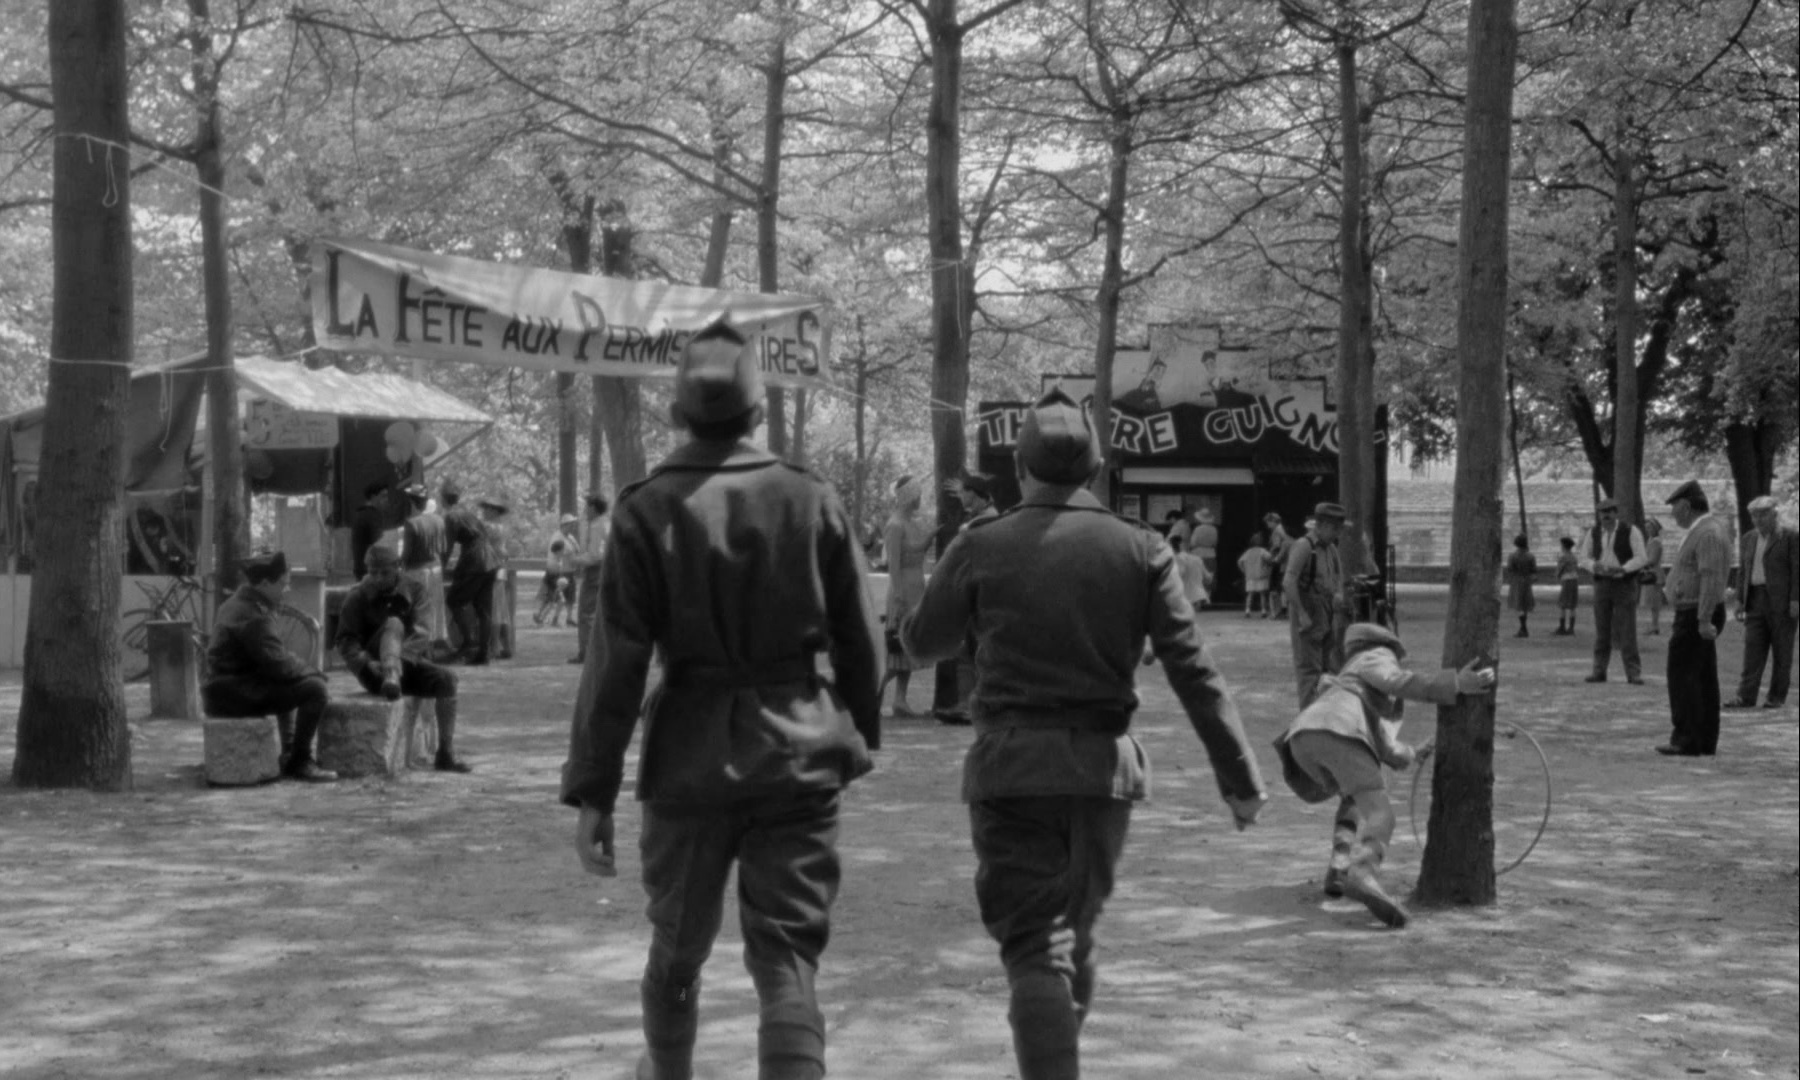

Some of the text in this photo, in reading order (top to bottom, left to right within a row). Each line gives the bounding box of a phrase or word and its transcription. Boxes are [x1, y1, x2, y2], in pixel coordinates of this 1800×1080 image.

[326, 249, 819, 376] LA FÊTE AUX PERMISIRES
[979, 394, 1386, 454] THRE GUIGN
